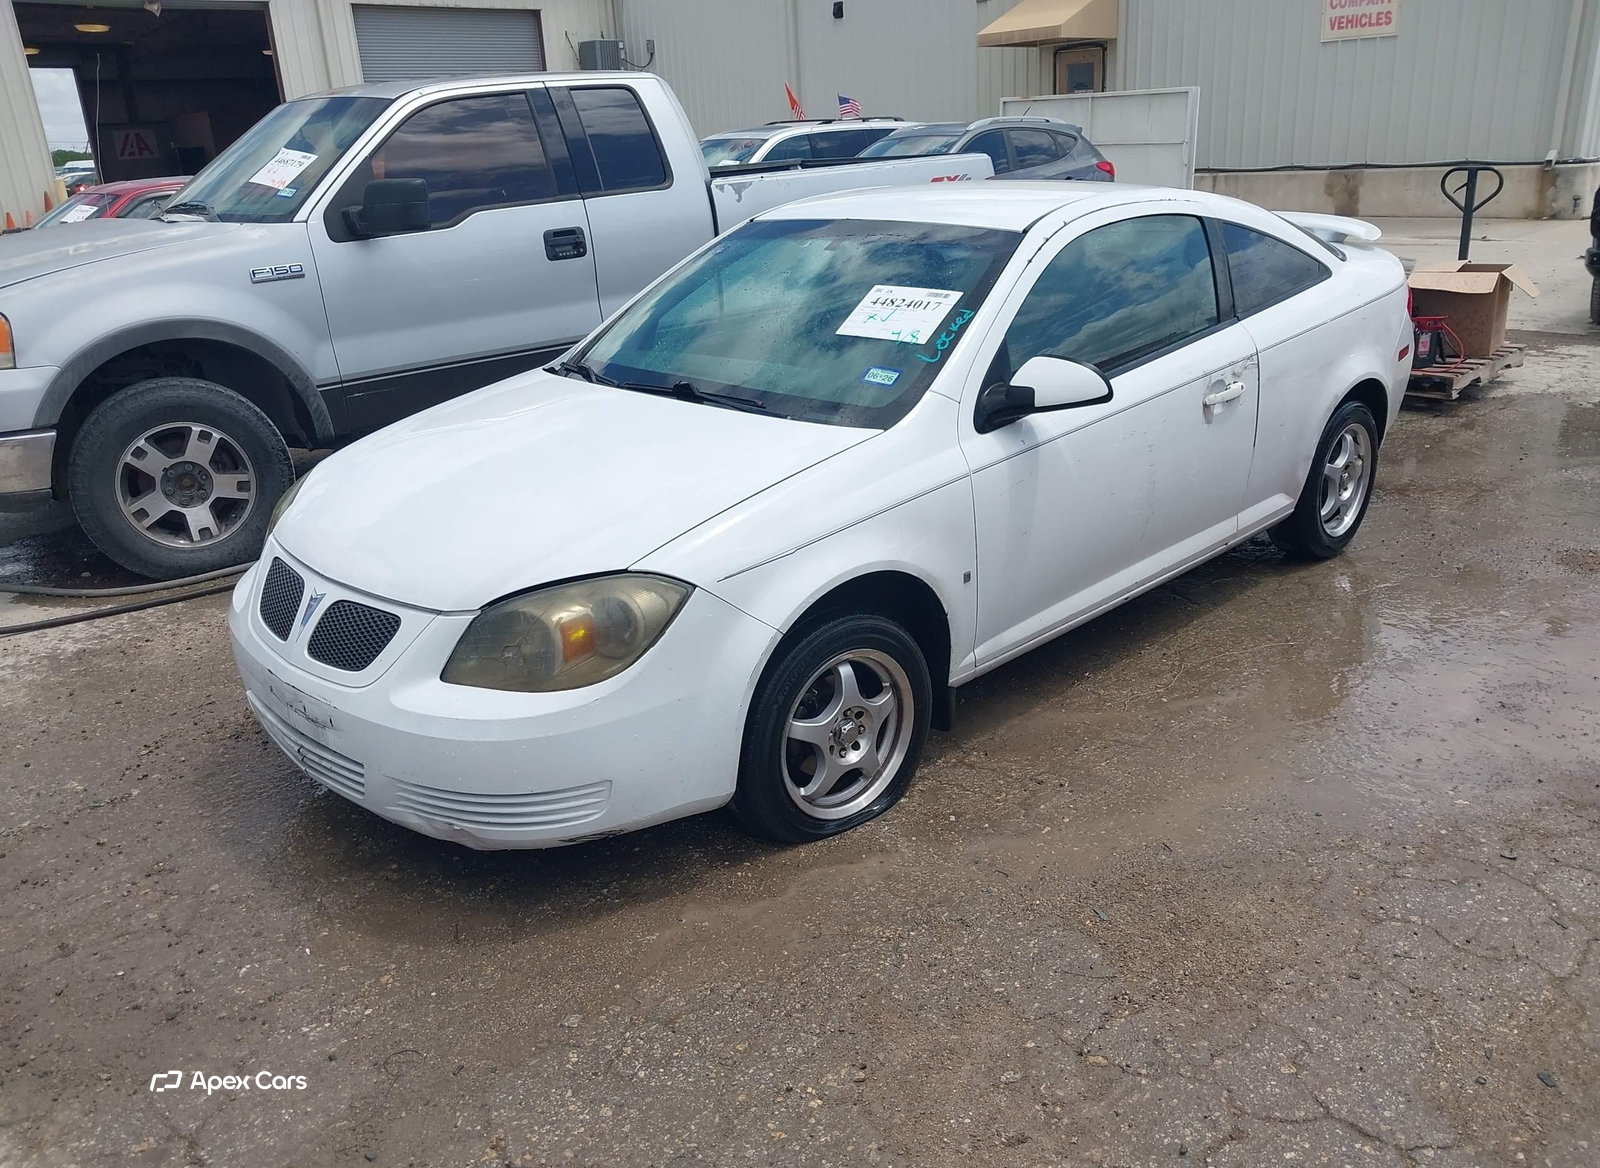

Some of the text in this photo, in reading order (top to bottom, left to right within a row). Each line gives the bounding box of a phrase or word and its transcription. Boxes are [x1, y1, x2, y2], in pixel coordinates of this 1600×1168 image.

[1330, 0, 1392, 10] COMP
[1329, 10, 1393, 31] VEHICLES
[870, 296, 943, 311] 44824017
